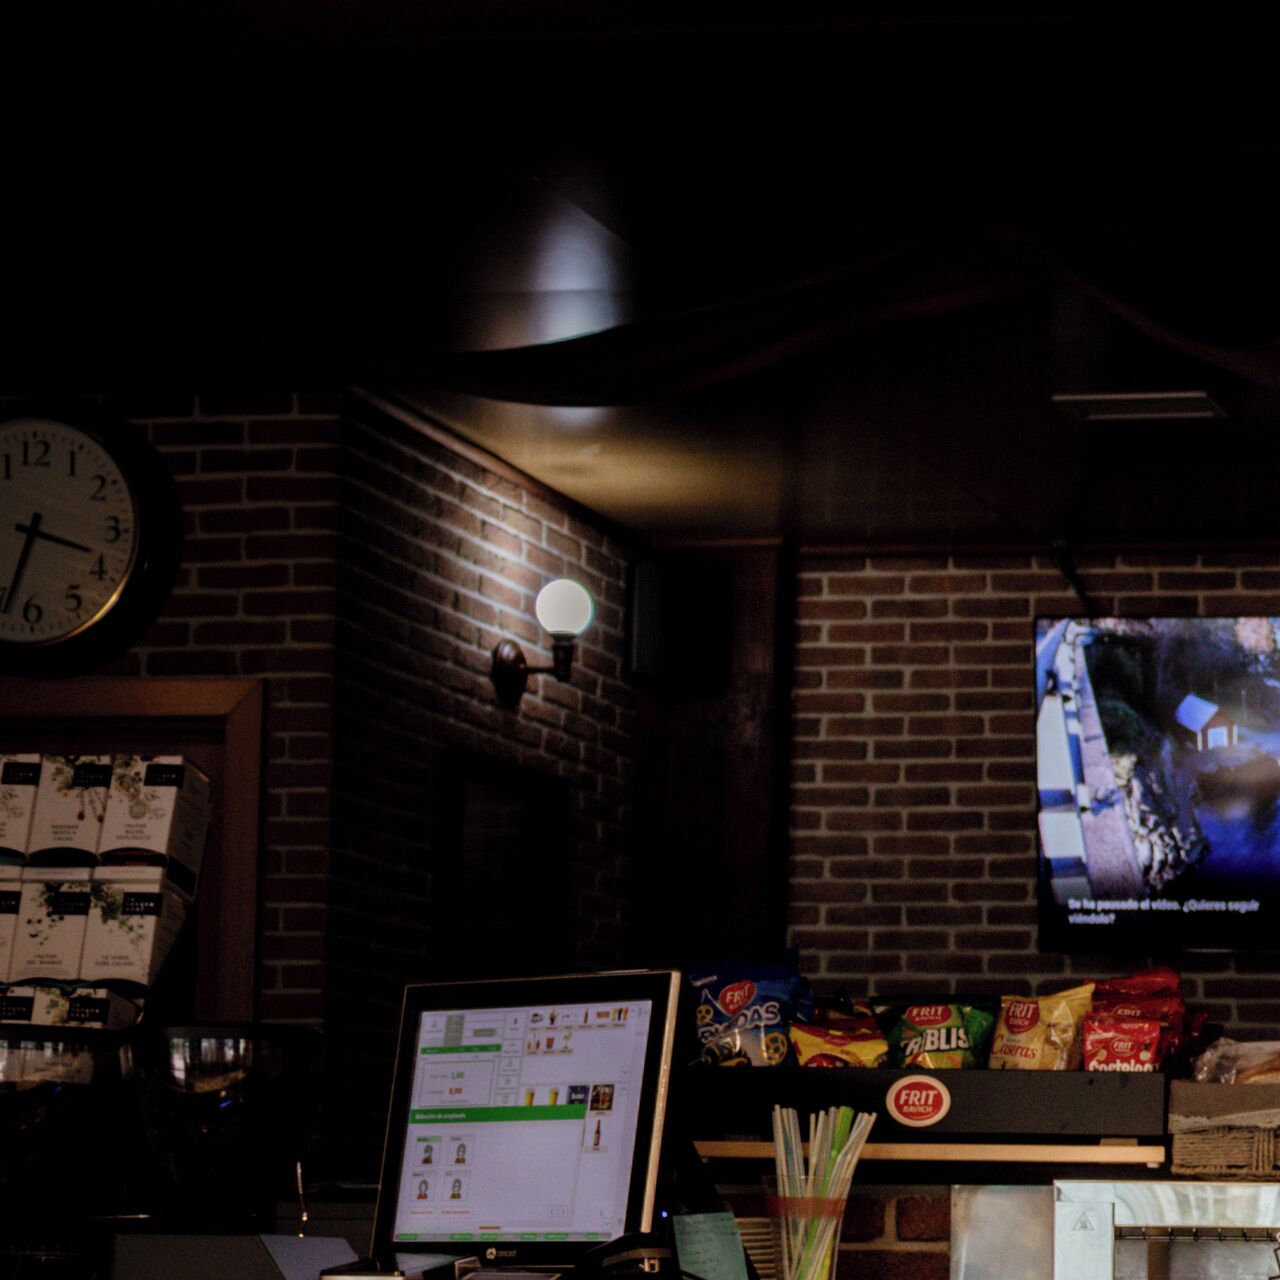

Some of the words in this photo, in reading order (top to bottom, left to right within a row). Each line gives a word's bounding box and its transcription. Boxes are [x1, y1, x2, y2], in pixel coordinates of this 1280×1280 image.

[21, 440, 50, 467] 12
[68, 451, 76, 477] 1
[89, 473, 108, 502] 2
[103, 516, 122, 544] 3
[88, 555, 108, 582] 4
[22, 594, 44, 625] 6
[64, 584, 83, 613] 5
[725, 985, 750, 1004] FRIT
[911, 1005, 946, 1017] FRIT
[1008, 1001, 1038, 1019] FRIT
[900, 1089, 938, 1106] FRIT
